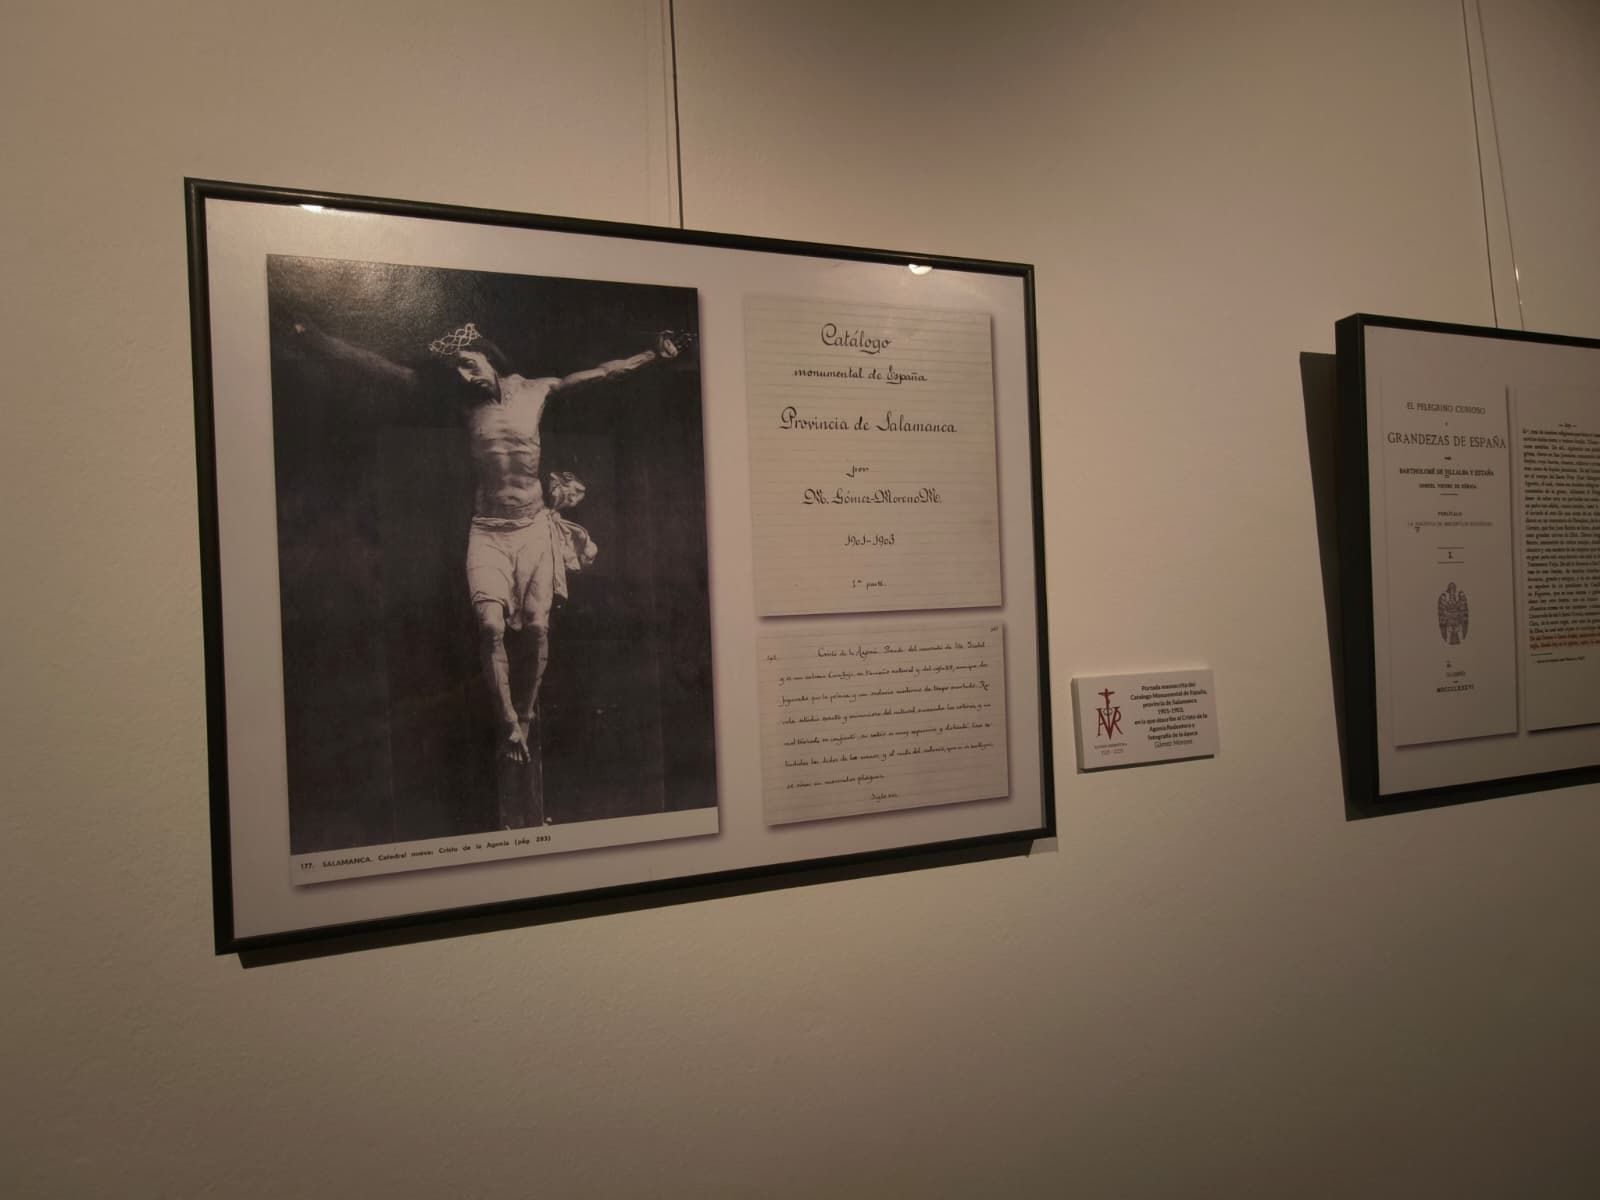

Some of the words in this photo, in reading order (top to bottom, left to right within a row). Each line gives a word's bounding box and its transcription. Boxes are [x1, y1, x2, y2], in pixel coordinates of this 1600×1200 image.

[821, 322, 892, 355] Catálogo
[794, 366, 864, 380] monumental
[868, 369, 882, 381] de
[780, 406, 850, 431] Provincia
[854, 416, 869, 432] de
[1387, 432, 1450, 447] GRANDEZAS
[1453, 435, 1467, 448] DE
[1469, 434, 1507, 449] ESPAÑA
[462, 844, 471, 852] de
